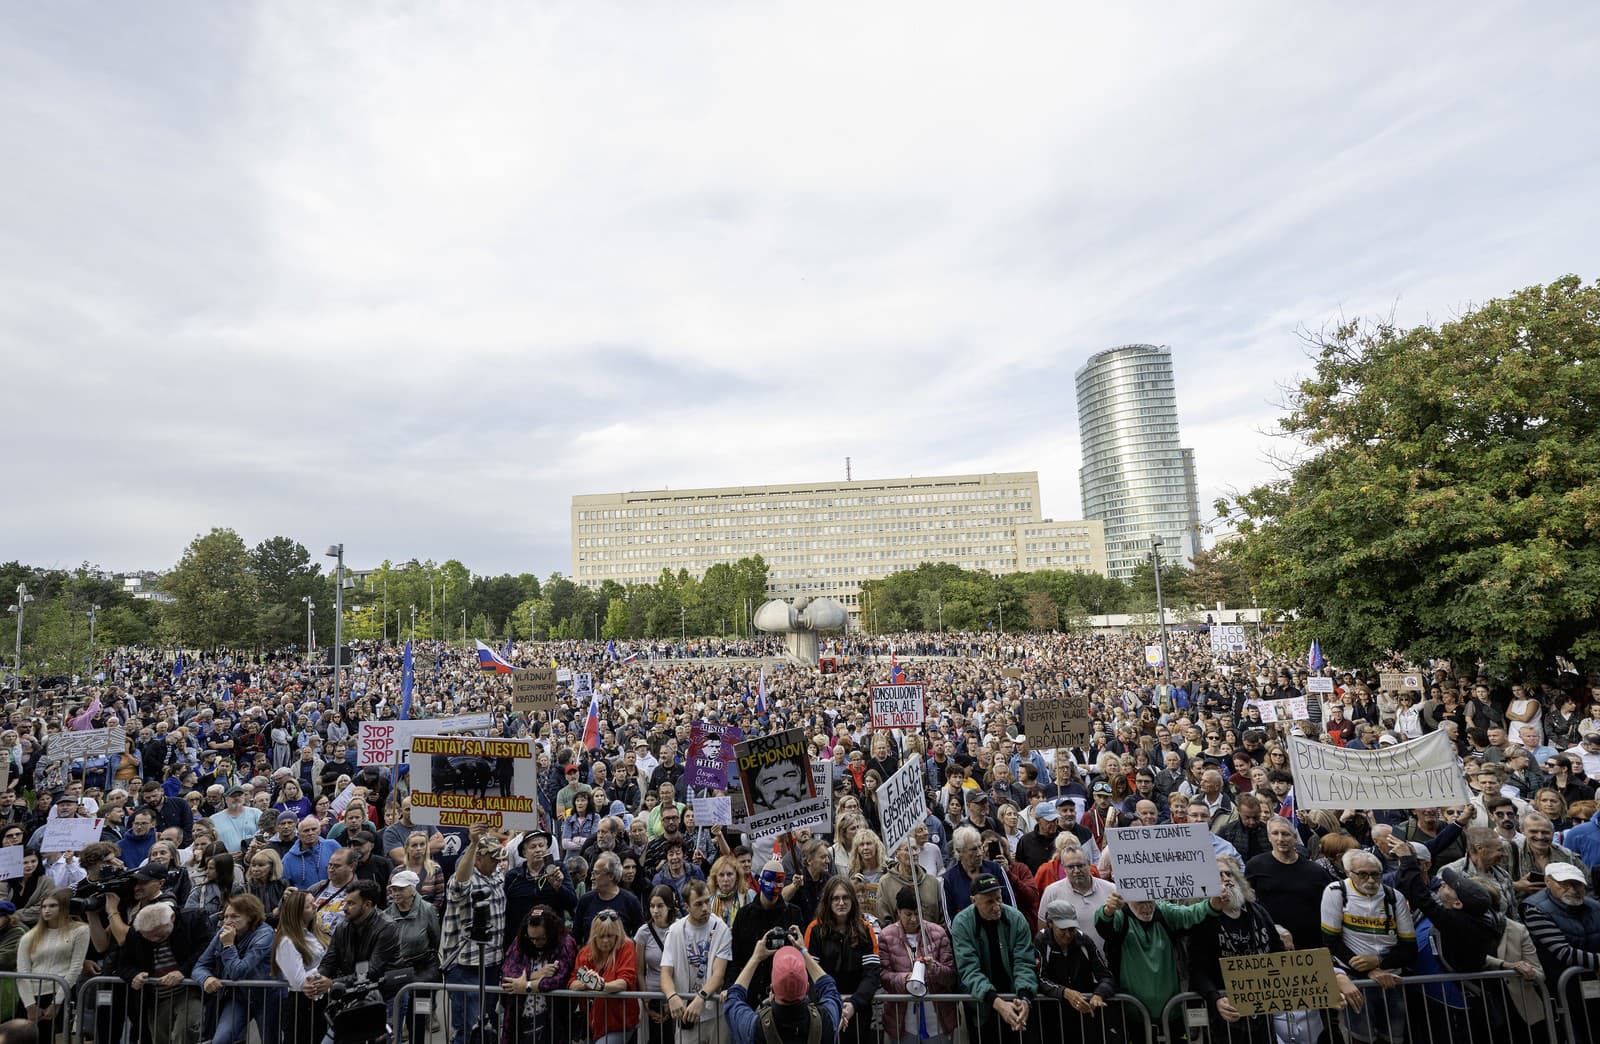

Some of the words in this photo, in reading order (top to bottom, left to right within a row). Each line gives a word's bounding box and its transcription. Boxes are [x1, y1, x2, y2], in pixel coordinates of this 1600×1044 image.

[871, 685, 921, 700] KONSOLIDOVAŤ
[902, 699, 916, 711] ALE
[1025, 698, 1083, 711] SLOVENSKO
[874, 713, 888, 726] NIE
[1043, 721, 1071, 733] ALE
[362, 724, 395, 738] STOP
[362, 738, 394, 750] STOP
[464, 739, 482, 756] SA
[485, 740, 532, 758] NESTAL
[747, 731, 790, 755] PROTI
[361, 750, 393, 764] STOP
[1301, 772, 1368, 802] VLÁDA
[411, 790, 439, 808] ŠUTA
[750, 801, 826, 830] BEZOHĽADNEJ
[748, 813, 828, 841] ĽAHOSTAJNOSTI
[1117, 829, 1141, 841] KEDY
[1142, 828, 1151, 840] SI
[1119, 876, 1161, 890] NEROBTE
[1165, 876, 1175, 888] Z
[1175, 872, 1195, 887] NÁS
[1227, 957, 1274, 971] ZRADCA
[1281, 953, 1314, 968] FICO
[1231, 971, 1320, 992] PUTINOVSKÁ
[1233, 982, 1329, 1005] PROTISLOVENSKÁ
